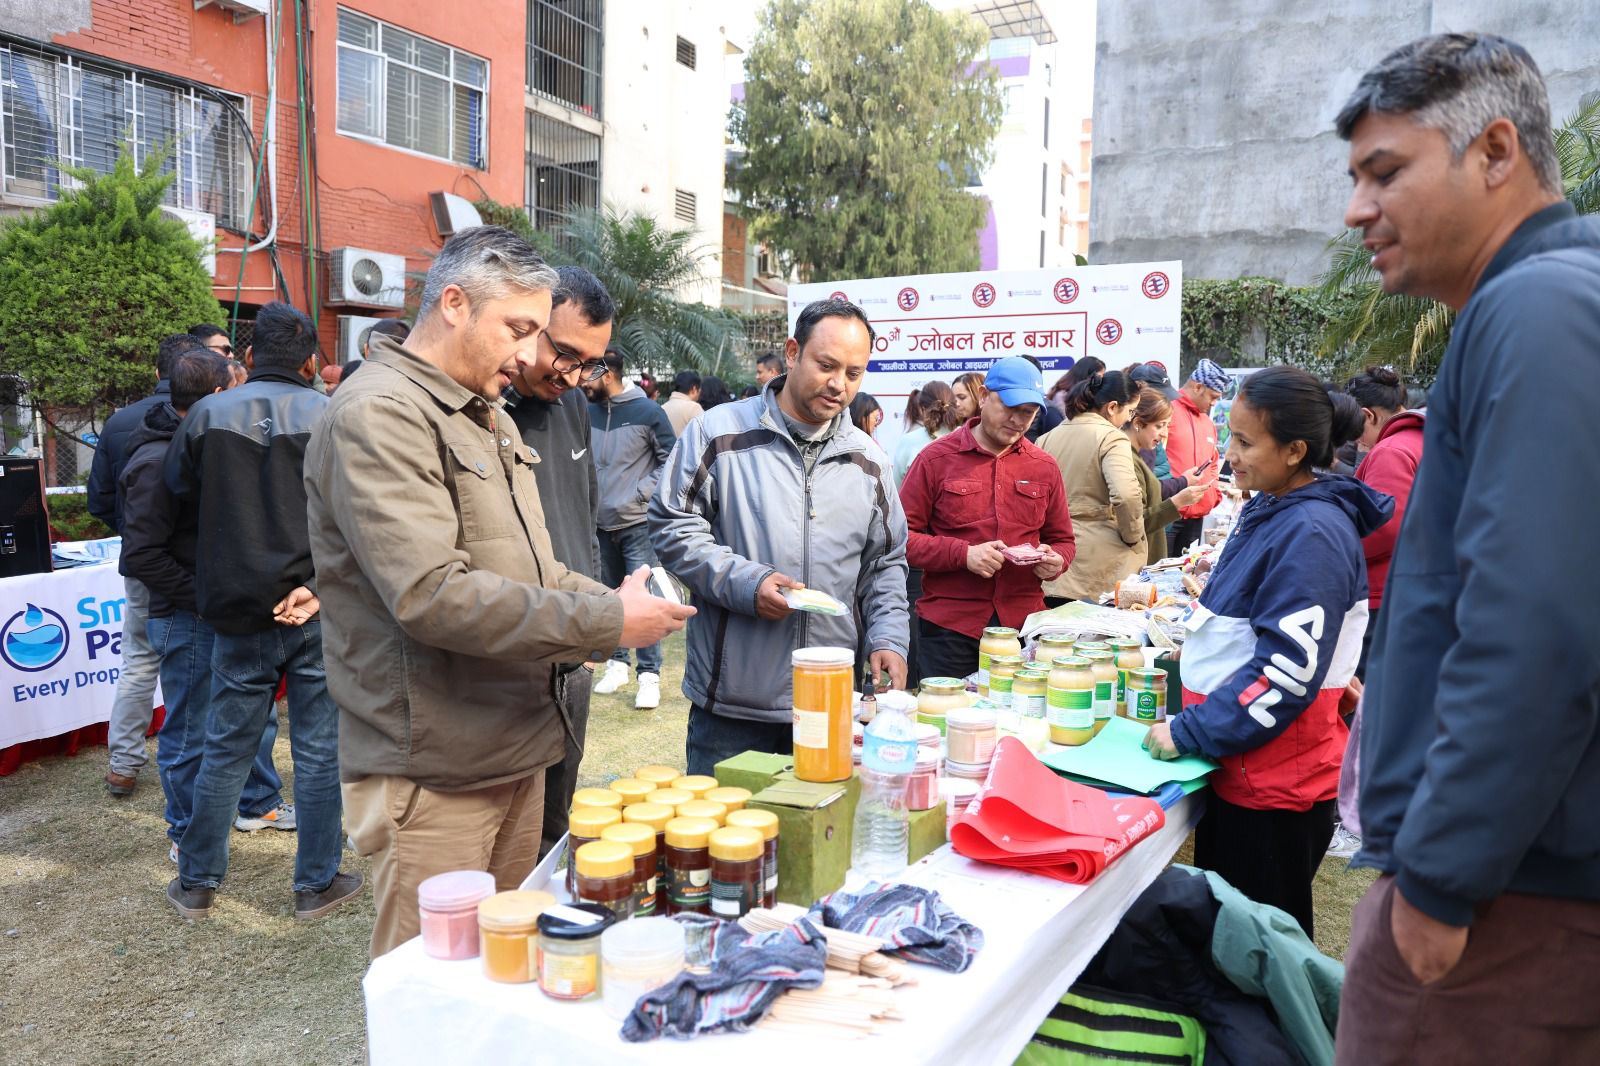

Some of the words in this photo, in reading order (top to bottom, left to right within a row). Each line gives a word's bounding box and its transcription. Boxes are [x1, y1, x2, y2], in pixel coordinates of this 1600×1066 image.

[907, 328, 975, 352] ग्लोबल
[982, 331, 1016, 352] हाट
[1023, 329, 1076, 349] बजार
[1238, 604, 1325, 729] FILA
[13, 678, 70, 703] Every
[75, 667, 120, 688] Drop
